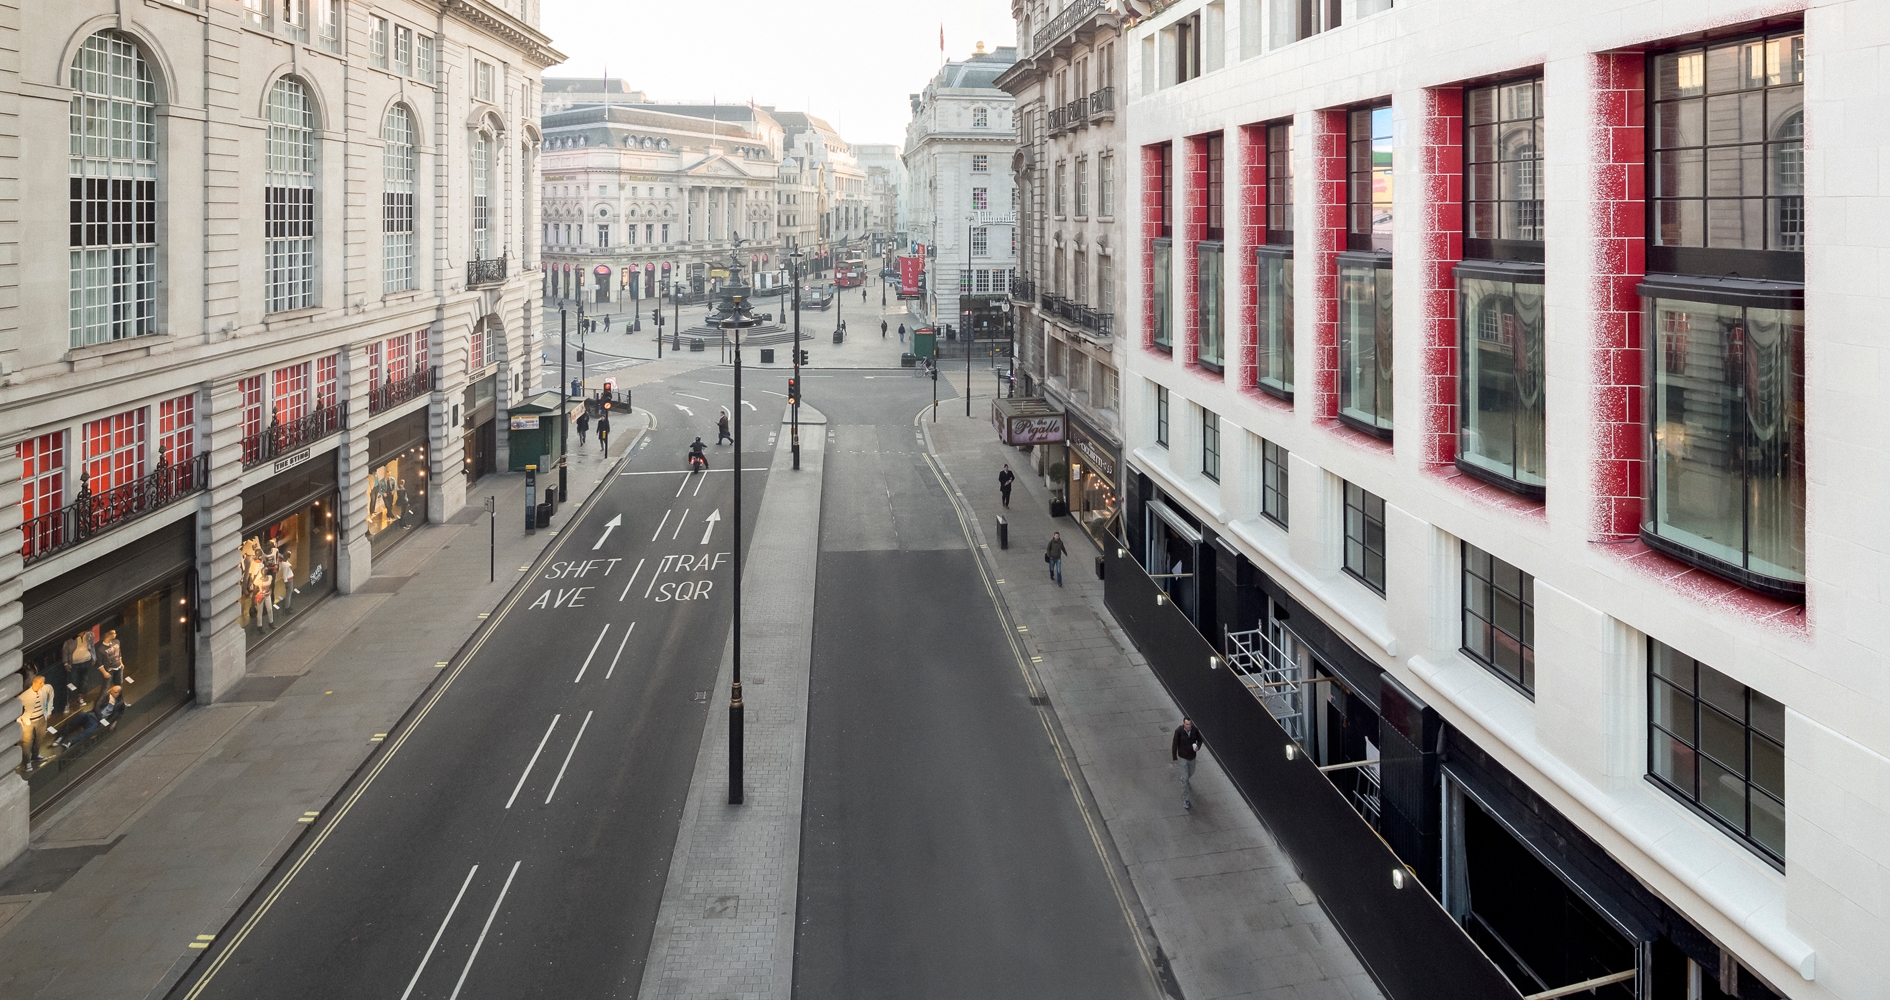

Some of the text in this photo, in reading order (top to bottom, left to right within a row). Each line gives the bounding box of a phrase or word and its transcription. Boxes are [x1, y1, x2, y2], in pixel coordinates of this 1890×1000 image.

[1014, 418, 1060, 441] Pigalle
[275, 451, 309, 470] THE STING
[545, 558, 622, 579] SHFT
[663, 552, 731, 573] TRAF
[528, 587, 595, 610] AVE
[655, 580, 713, 602] SQR
